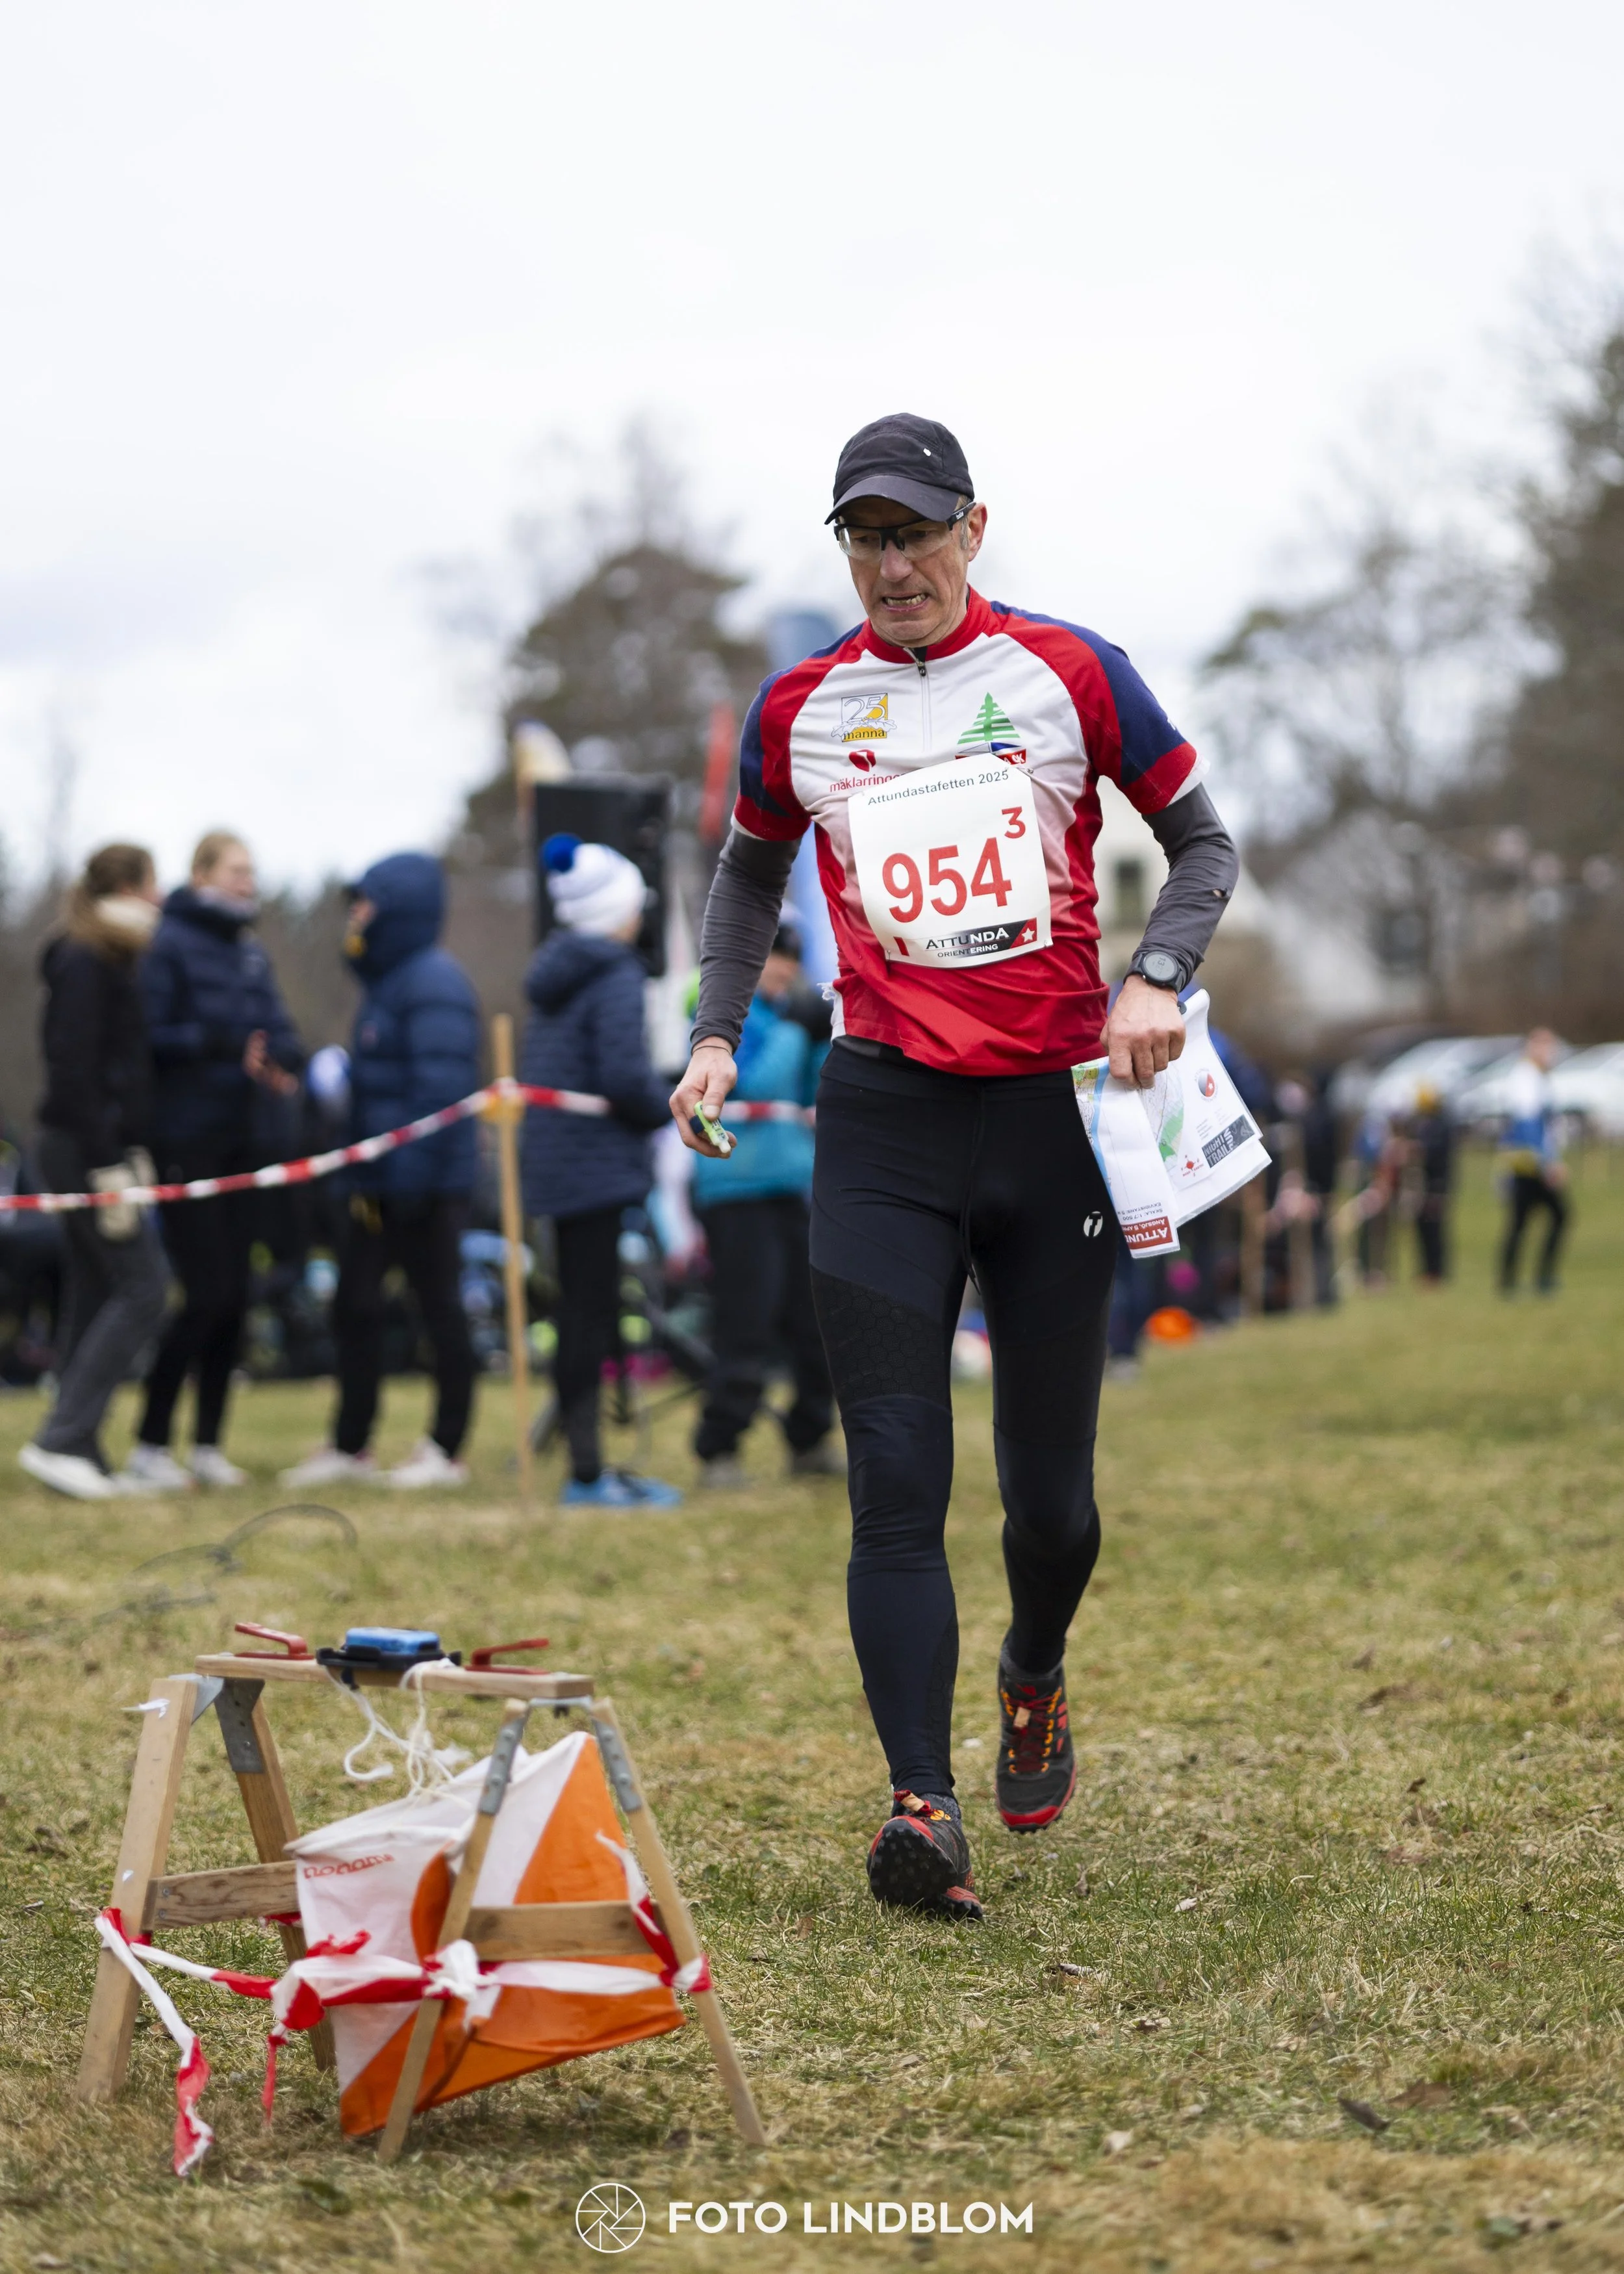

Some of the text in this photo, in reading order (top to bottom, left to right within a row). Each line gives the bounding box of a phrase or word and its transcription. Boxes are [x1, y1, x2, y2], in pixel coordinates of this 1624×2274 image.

[843, 695, 886, 722] 25
[843, 728, 886, 740] manna
[867, 769, 1009, 806] Attundastafetten 2025
[1001, 806, 1026, 839] 3
[882, 836, 1013, 924] 954
[926, 927, 1010, 950] ATTUNDA
[937, 943, 998, 958] ORIENTERING
[1206, 1143, 1230, 1167] TRAIL
